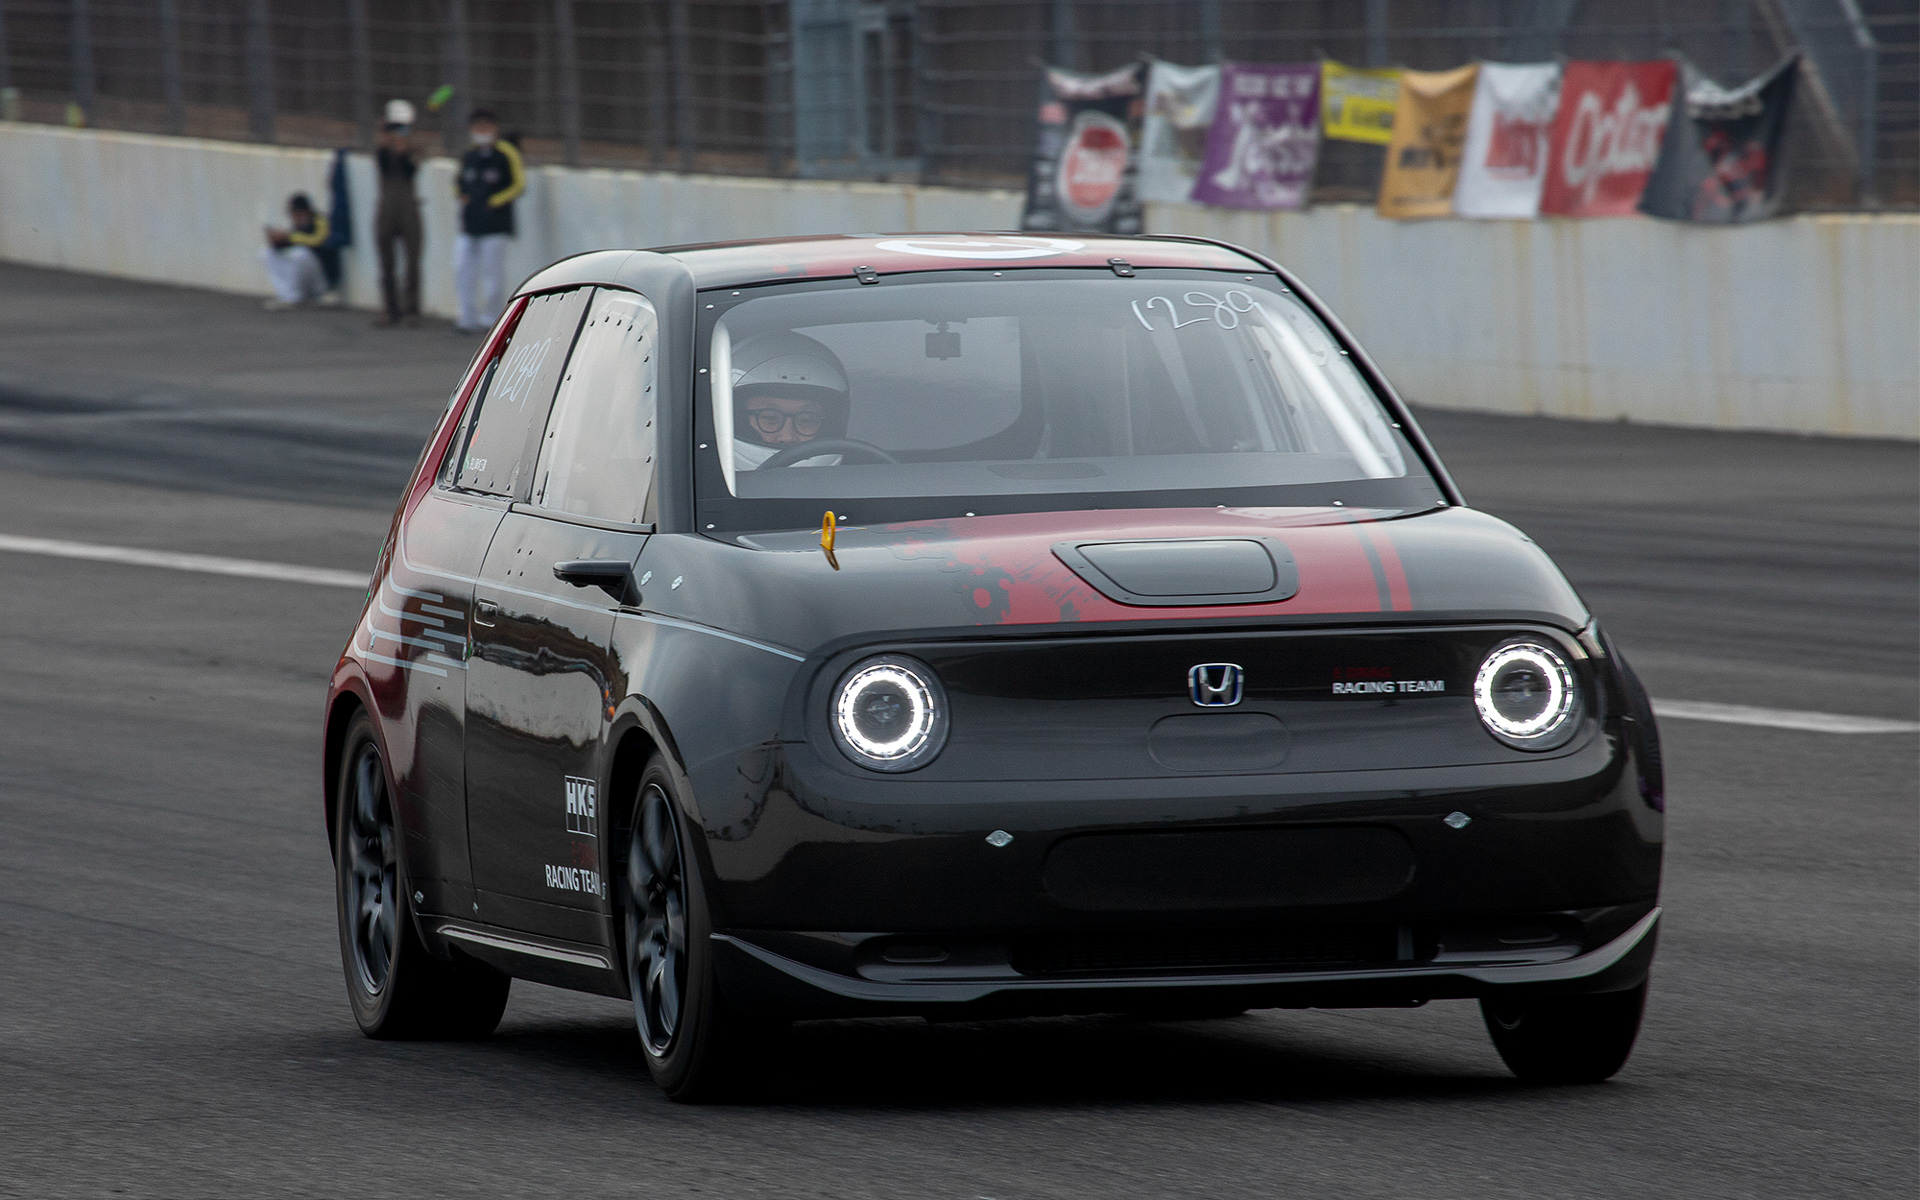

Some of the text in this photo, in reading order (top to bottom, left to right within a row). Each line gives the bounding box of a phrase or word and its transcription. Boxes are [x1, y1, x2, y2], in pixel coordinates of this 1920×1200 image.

[1332, 680, 1446, 694] RACING TEAM
[566, 781, 595, 818] HKS
[545, 864, 580, 892] RACING
